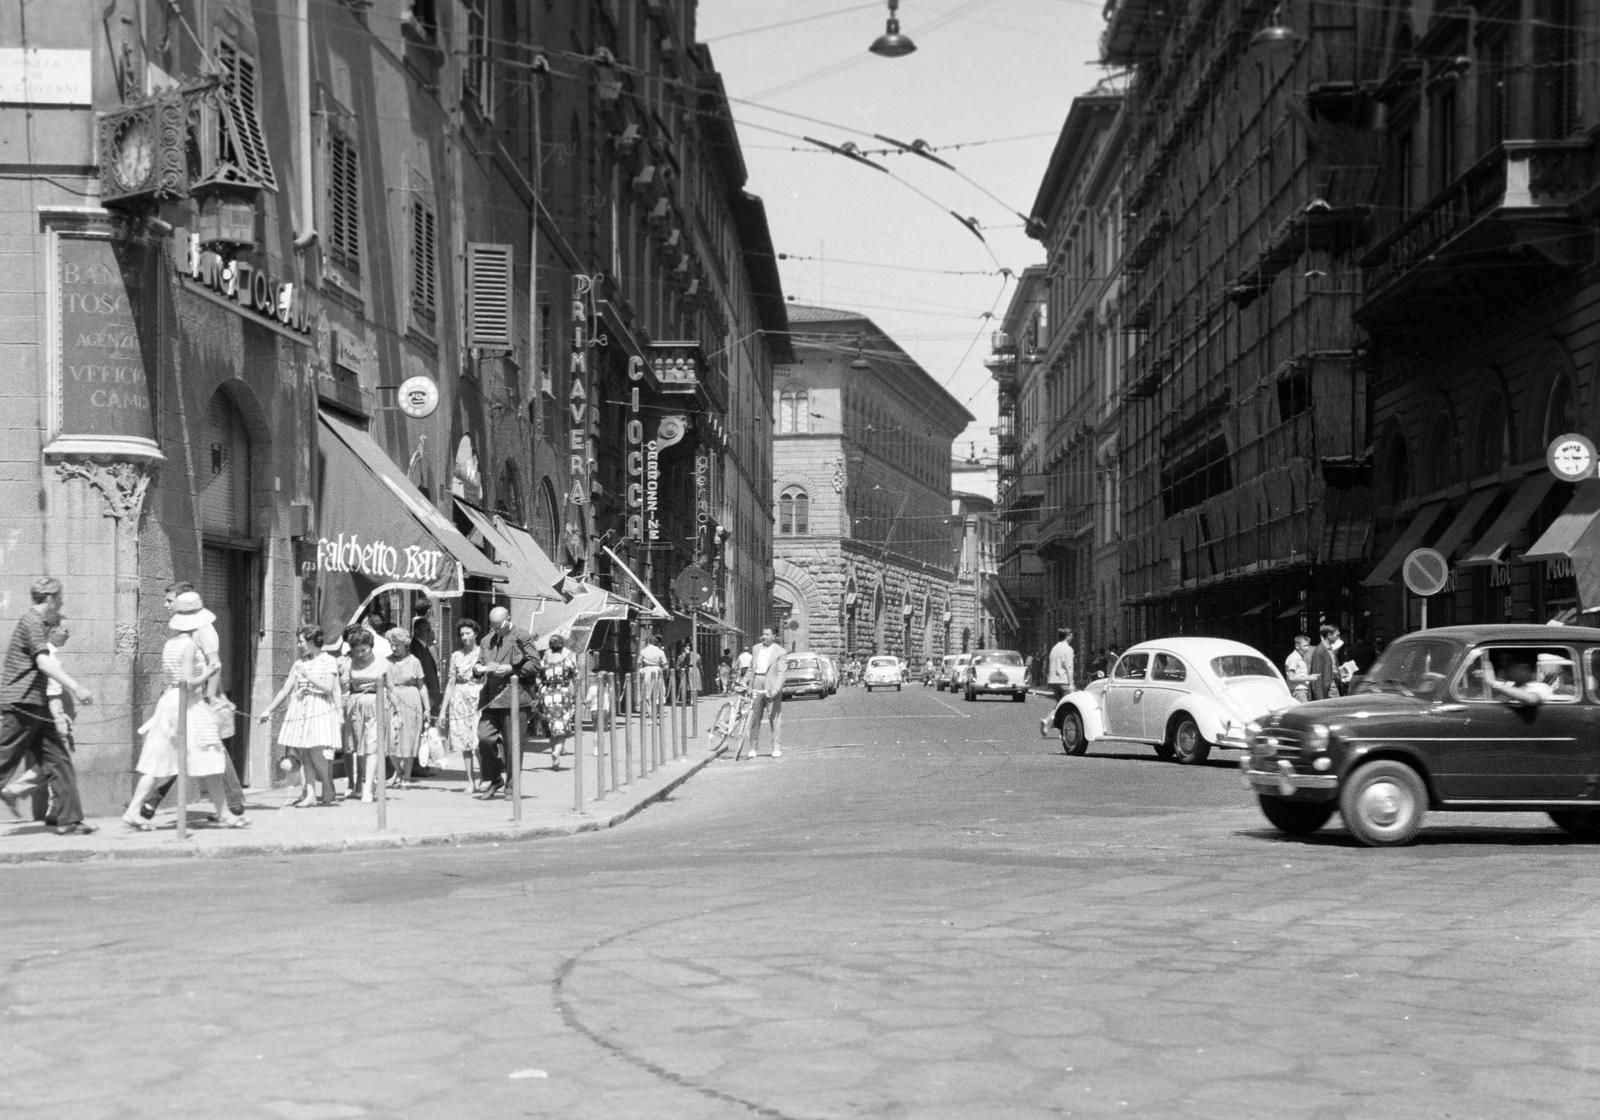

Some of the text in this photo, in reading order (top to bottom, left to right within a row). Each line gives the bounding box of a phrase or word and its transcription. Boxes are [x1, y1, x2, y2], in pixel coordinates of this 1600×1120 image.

[570, 274, 591, 500] PRIMAVERA
[627, 355, 643, 540] CIOCCA
[647, 440, 660, 540] CARROZZINE
[403, 544, 443, 581] Bar
